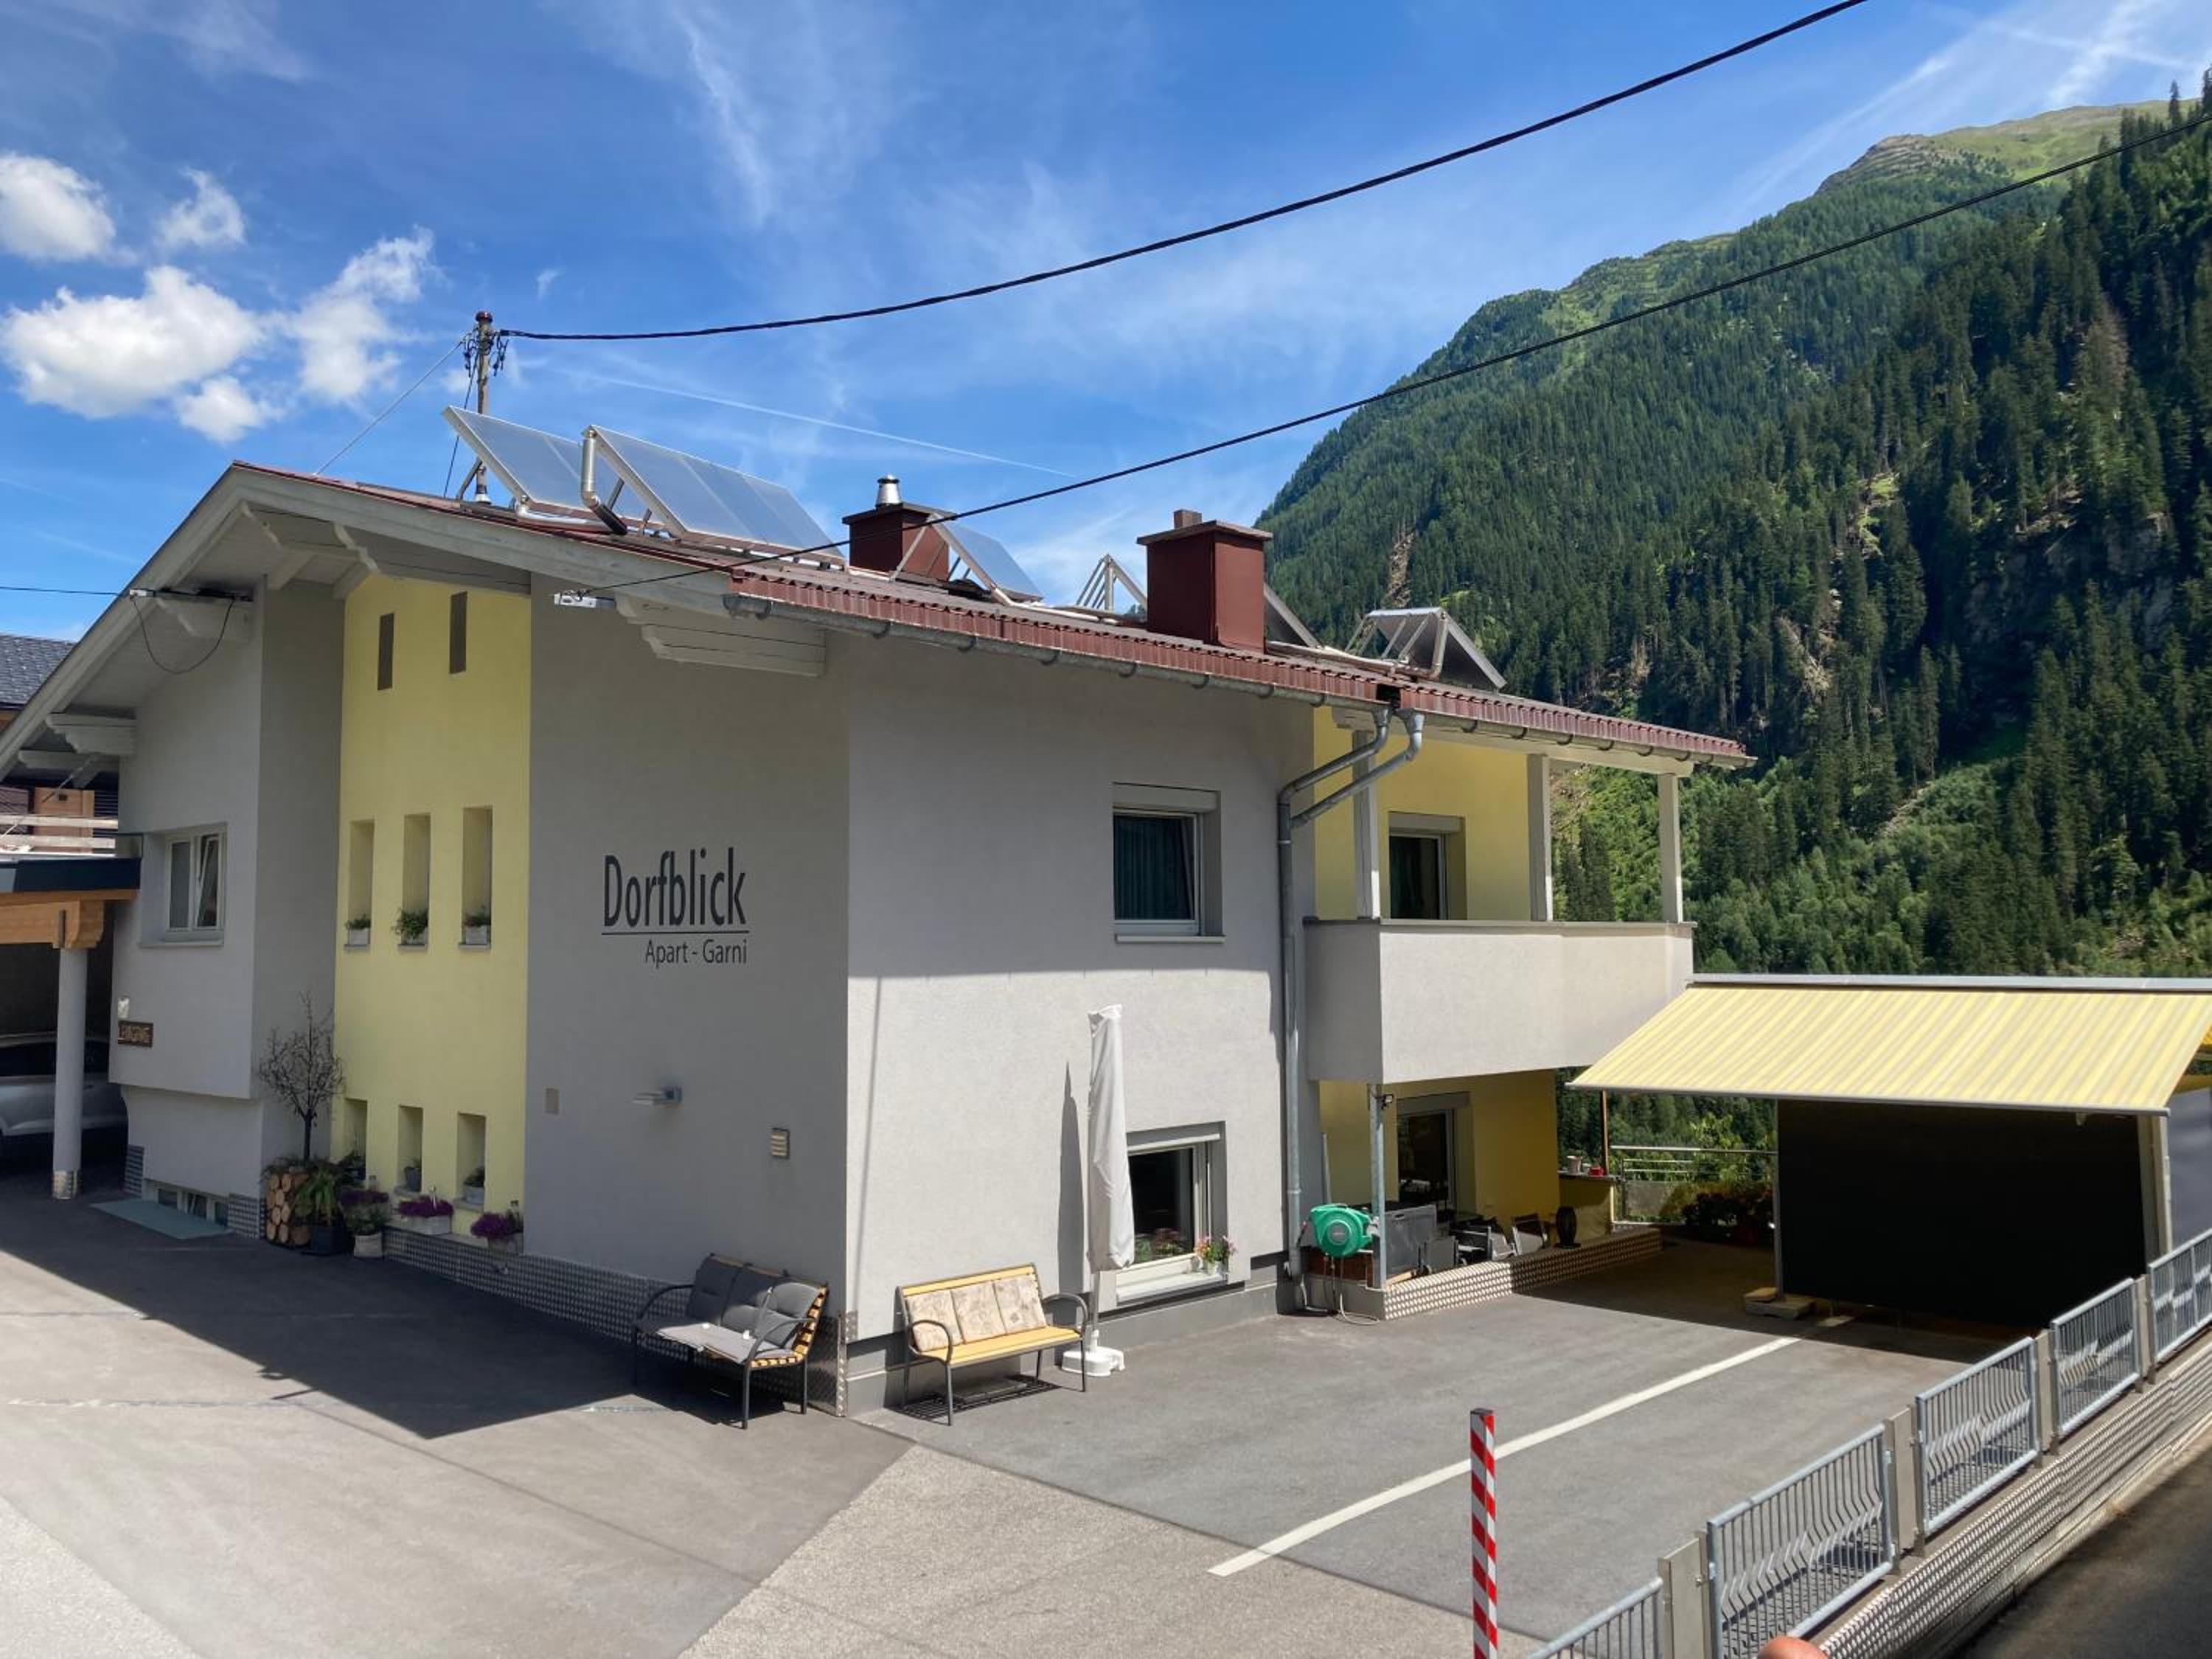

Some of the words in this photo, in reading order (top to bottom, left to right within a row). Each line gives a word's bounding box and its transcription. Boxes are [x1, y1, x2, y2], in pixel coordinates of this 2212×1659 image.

[604, 847, 746, 927] Dorfblick
[645, 939, 689, 969] Apart
[703, 939, 748, 964] Garni
